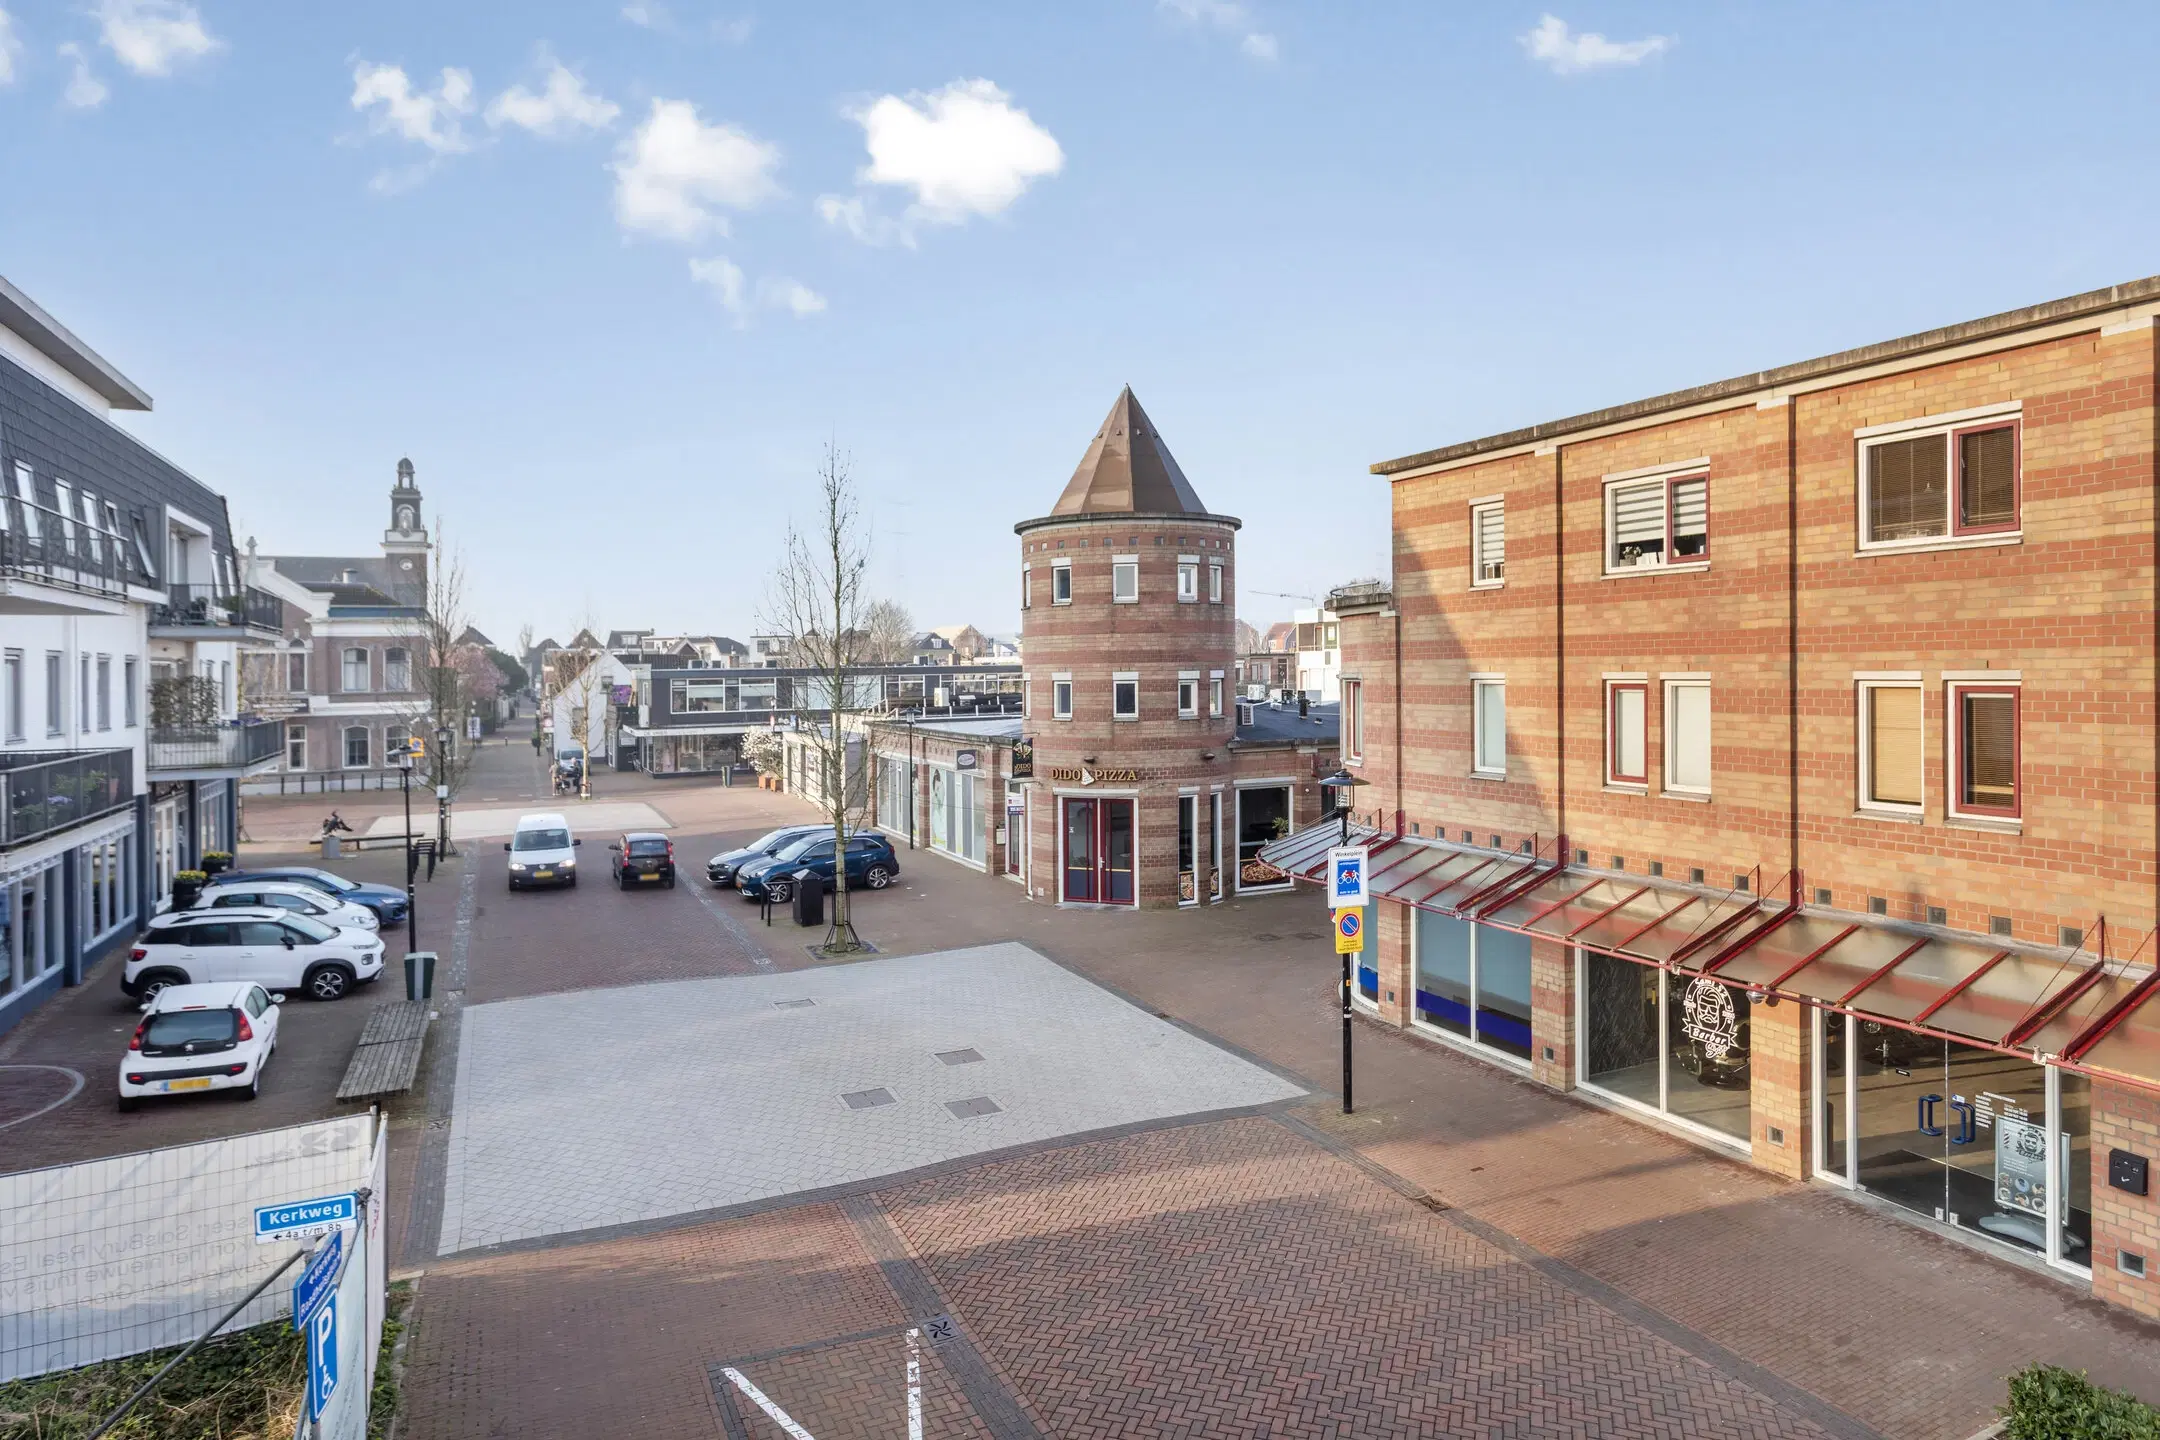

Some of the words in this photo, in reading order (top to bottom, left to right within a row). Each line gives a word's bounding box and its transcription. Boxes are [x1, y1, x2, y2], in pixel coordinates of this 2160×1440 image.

[1052, 768, 1081, 780] DIDO
[1094, 769, 1138, 781] PIZZA
[1692, 1027, 1727, 1045] Barber
[269, 1203, 342, 1225] Kerkweg
[285, 1230, 299, 1240] 4a
[303, 1226, 324, 1236] t/m
[328, 1223, 342, 1232] 8b
